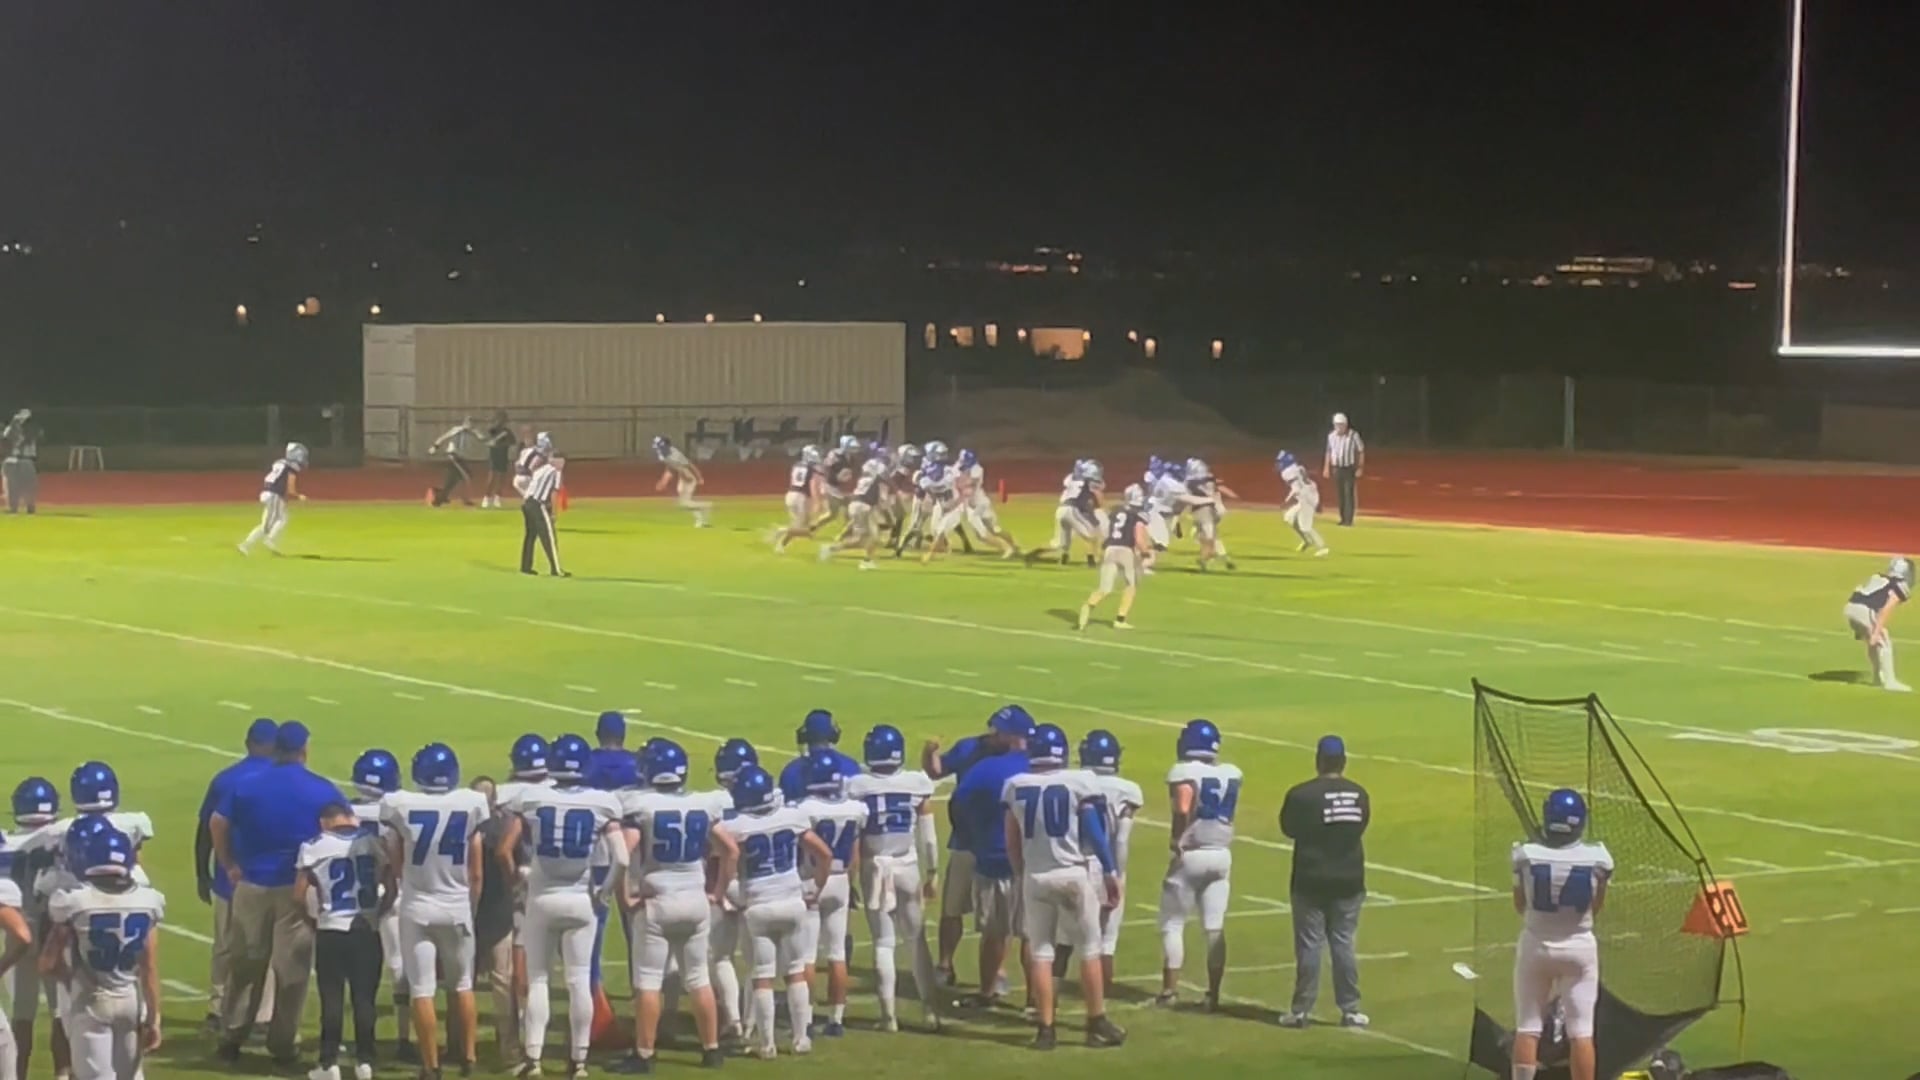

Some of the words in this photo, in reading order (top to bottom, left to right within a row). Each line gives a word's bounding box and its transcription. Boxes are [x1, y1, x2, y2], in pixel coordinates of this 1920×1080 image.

[408, 809, 469, 866] 74
[536, 806, 596, 859] 10
[653, 809, 709, 863] 58
[864, 792, 912, 834] 15
[1015, 784, 1070, 839] 70
[745, 828, 796, 880] 20
[1530, 864, 1593, 913] 14
[89, 912, 151, 972] 52
